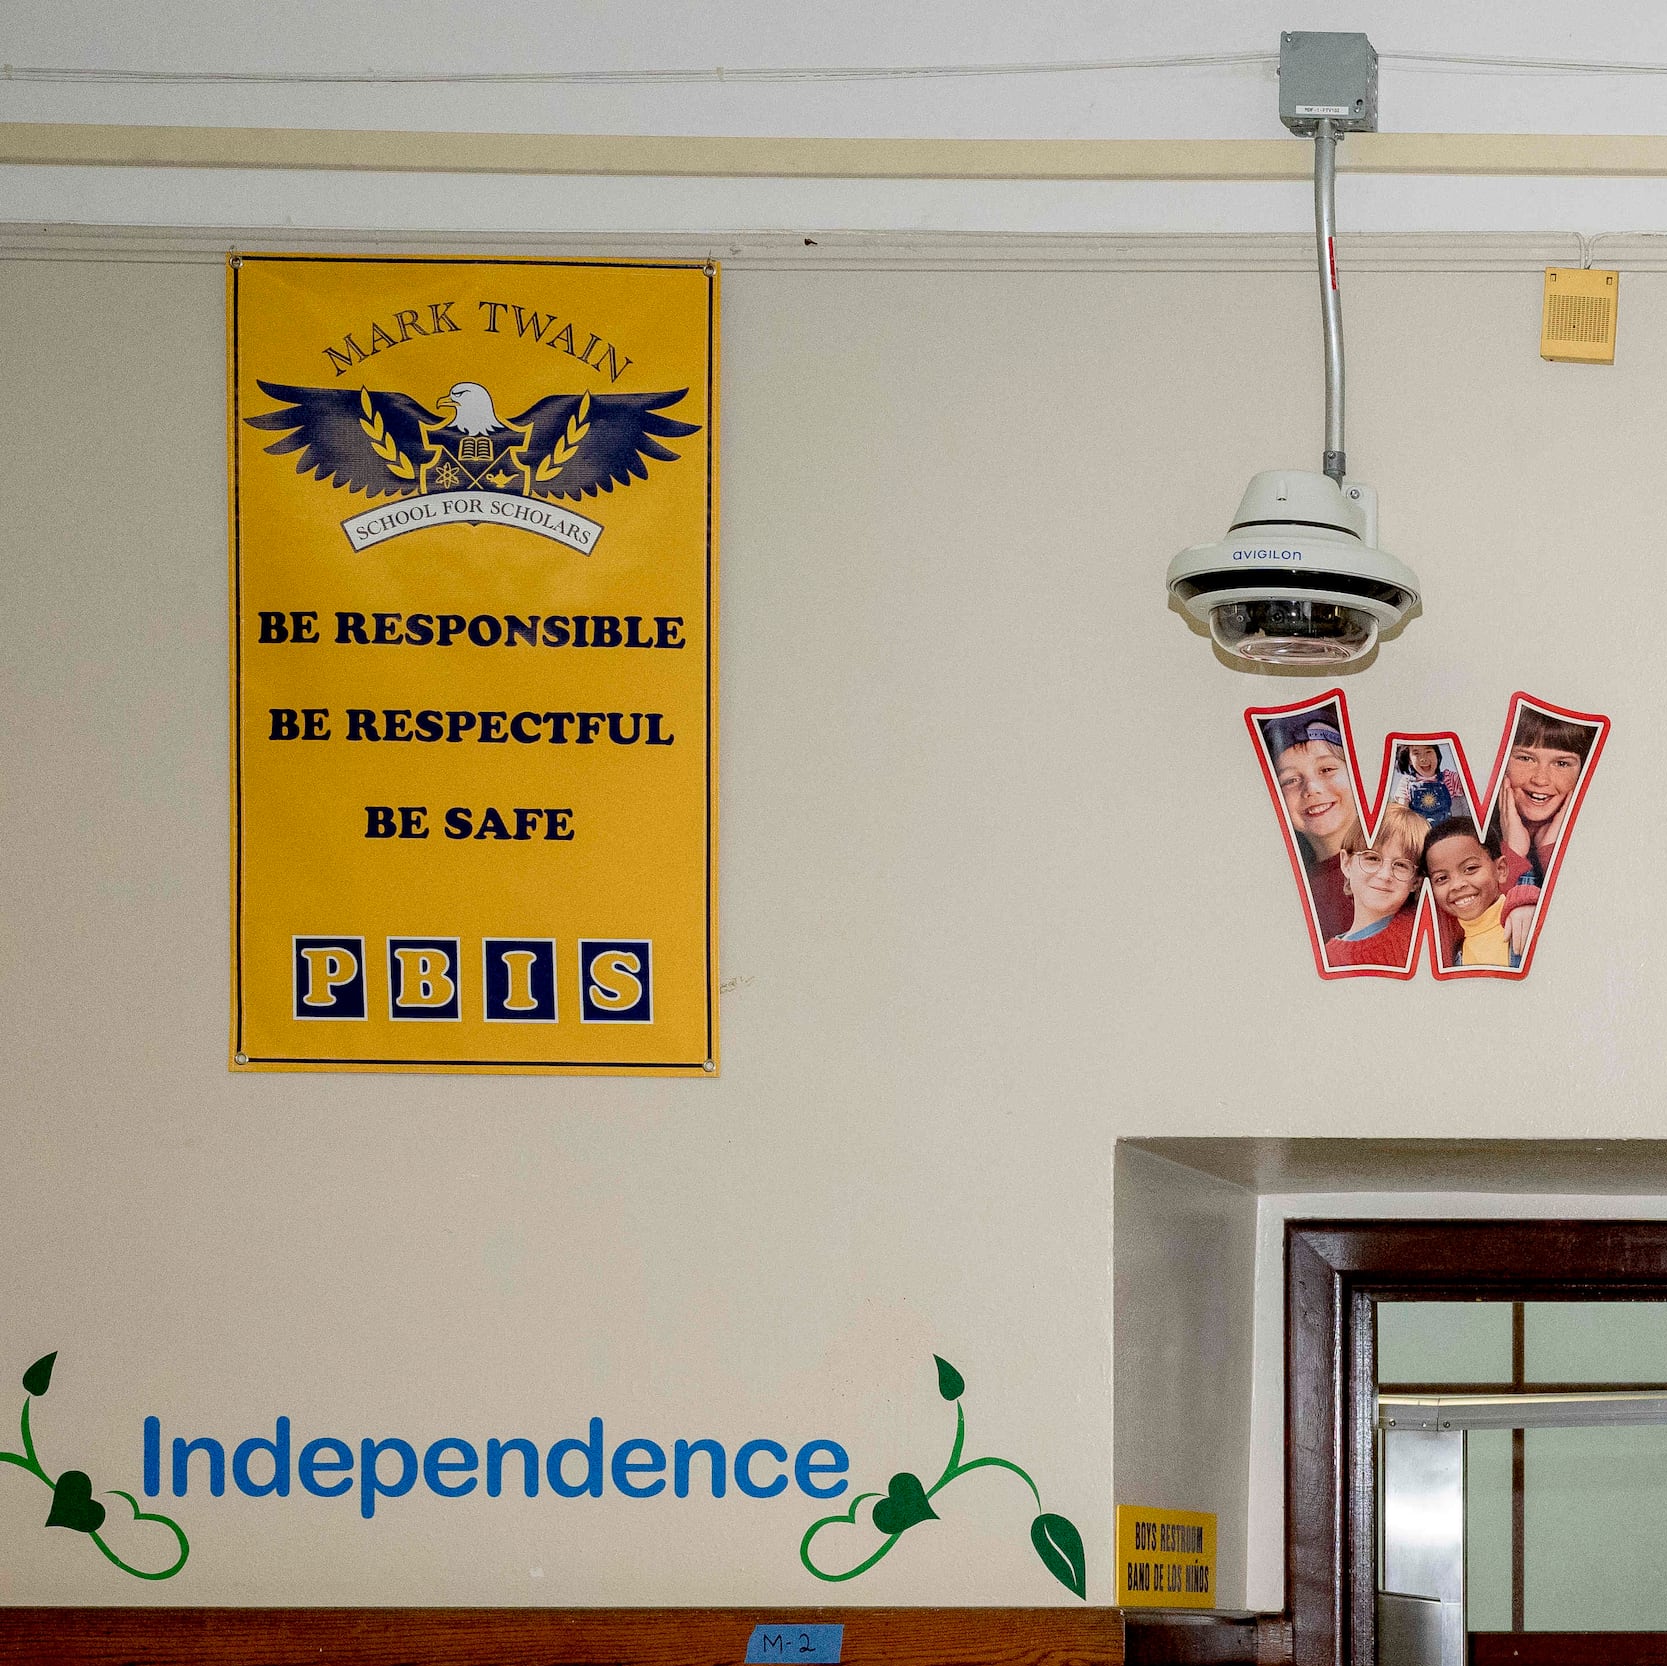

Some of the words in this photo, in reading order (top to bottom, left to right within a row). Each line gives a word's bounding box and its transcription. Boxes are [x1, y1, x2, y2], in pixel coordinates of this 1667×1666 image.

[322, 302, 461, 377] MARK
[479, 301, 633, 383] TWAIN
[355, 501, 438, 544] SCHOOL
[441, 498, 484, 518] FOR
[488, 501, 594, 547] SCHOLARS
[258, 611, 320, 644] BE
[335, 612, 685, 649] RESPONSIBLE
[269, 708, 331, 740] BE
[346, 709, 674, 745] RESPECTFUL
[365, 806, 429, 839] BE
[444, 807, 574, 840] SAFE
[143, 1416, 849, 1519] Independence
[1135, 1522, 1157, 1551] BOYS
[1160, 1524, 1203, 1553] RESTROOM
[1154, 1564, 1163, 1591] DE
[1167, 1564, 1182, 1592] LOS
